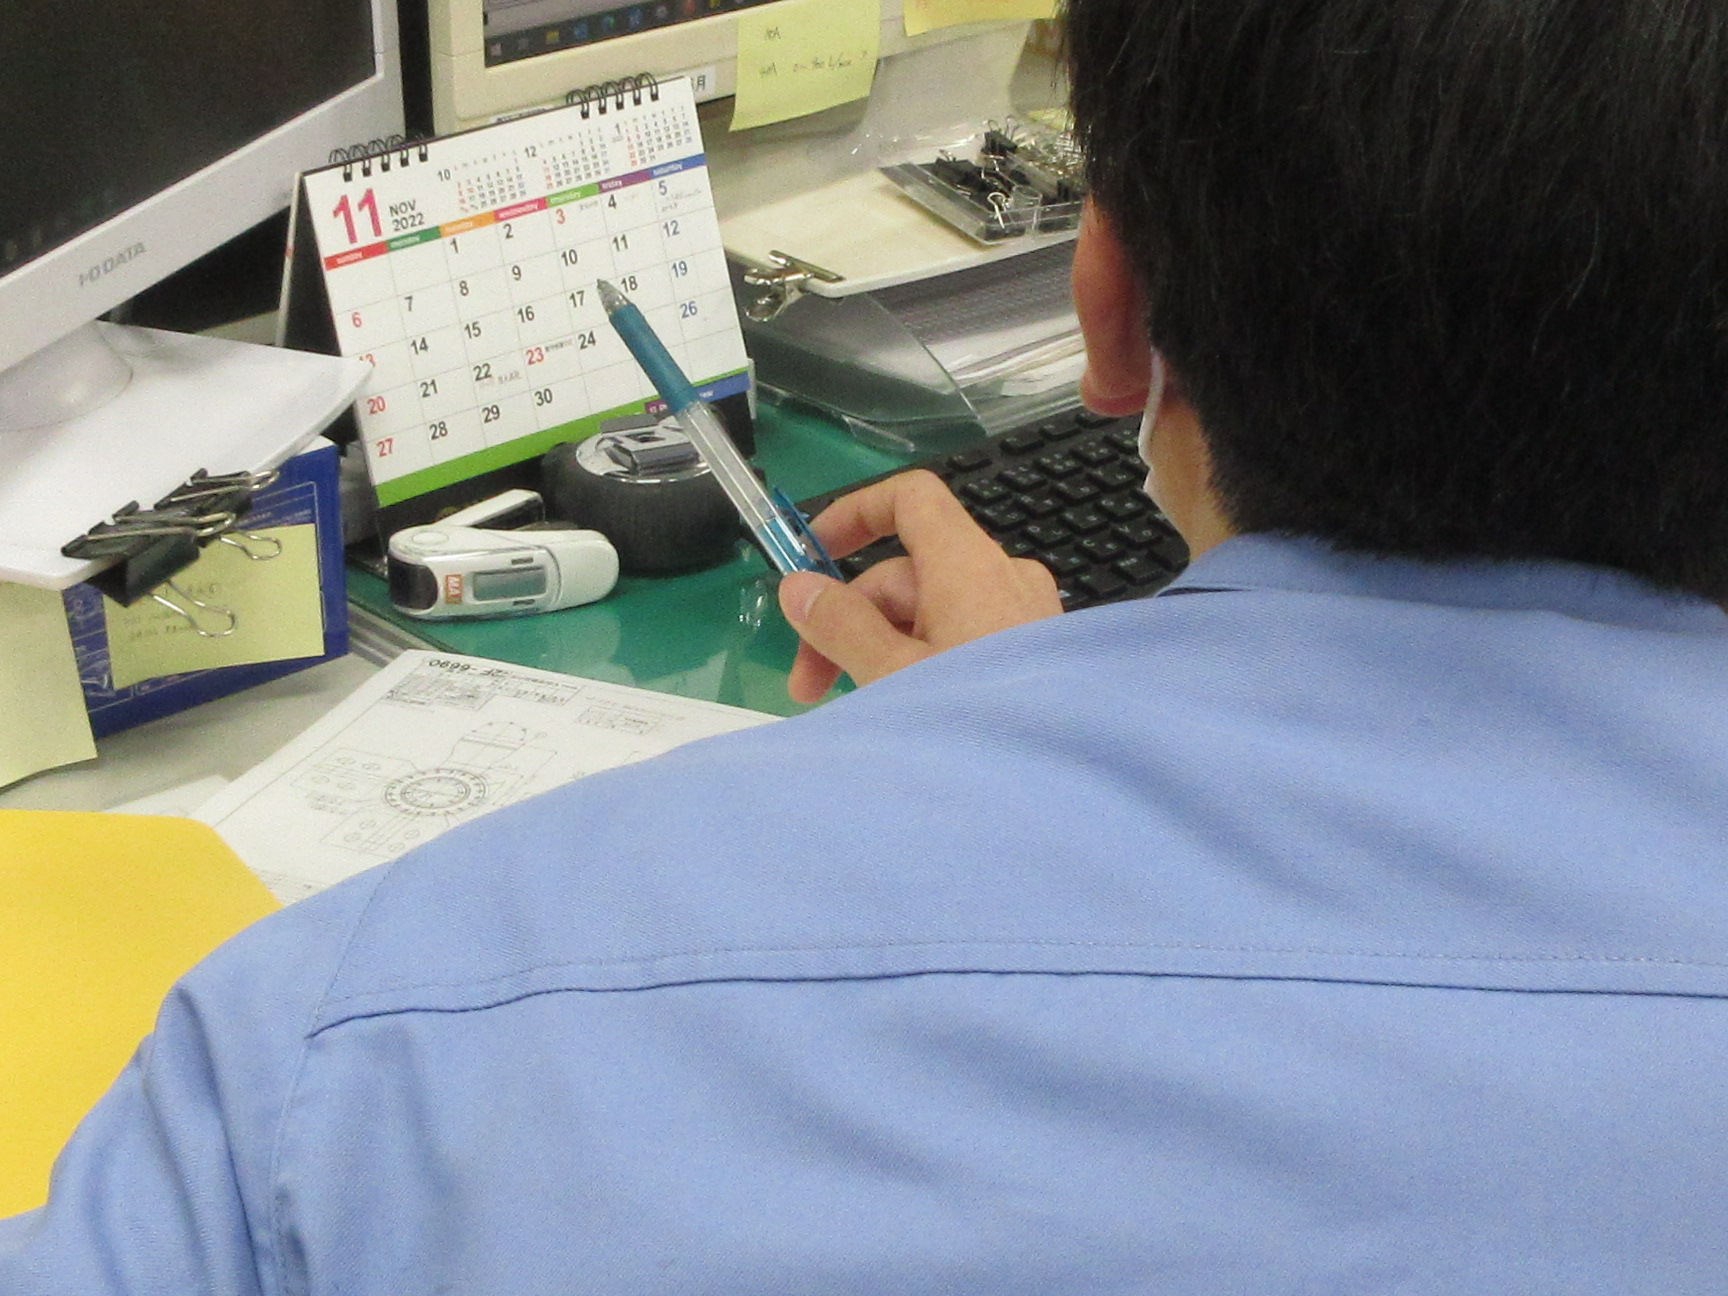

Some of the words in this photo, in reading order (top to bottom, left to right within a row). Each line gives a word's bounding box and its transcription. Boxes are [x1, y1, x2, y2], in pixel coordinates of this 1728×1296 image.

[437, 168, 452, 182] 10
[524, 145, 537, 158] 12
[332, 188, 383, 244] 11
[389, 199, 417, 217] NOV
[392, 213, 425, 232] 2022
[449, 238, 459, 254] 1
[503, 223, 514, 239] 2
[555, 208, 566, 225] 3
[607, 193, 618, 209] 4
[658, 180, 668, 196] 5
[351, 312, 363, 328] 6
[404, 295, 414, 312] 7
[459, 280, 470, 297] 8
[512, 265, 522, 281] 9
[561, 249, 578, 267] 10
[612, 235, 629, 253] 11
[663, 220, 680, 238] 12
[410, 337, 429, 355] 14
[464, 321, 482, 339] 15
[517, 306, 535, 324] 16
[569, 290, 585, 308] 17
[620, 275, 638, 293] 18
[671, 260, 688, 278] 19
[367, 396, 386, 415] 20
[420, 379, 438, 398] 21
[473, 363, 491, 382] 22
[526, 347, 545, 366] 23
[578, 331, 597, 350] 24
[680, 301, 698, 319] 26
[376, 437, 394, 457] 27
[429, 421, 448, 440] 28
[482, 405, 500, 424] 29
[534, 388, 553, 406] 30
